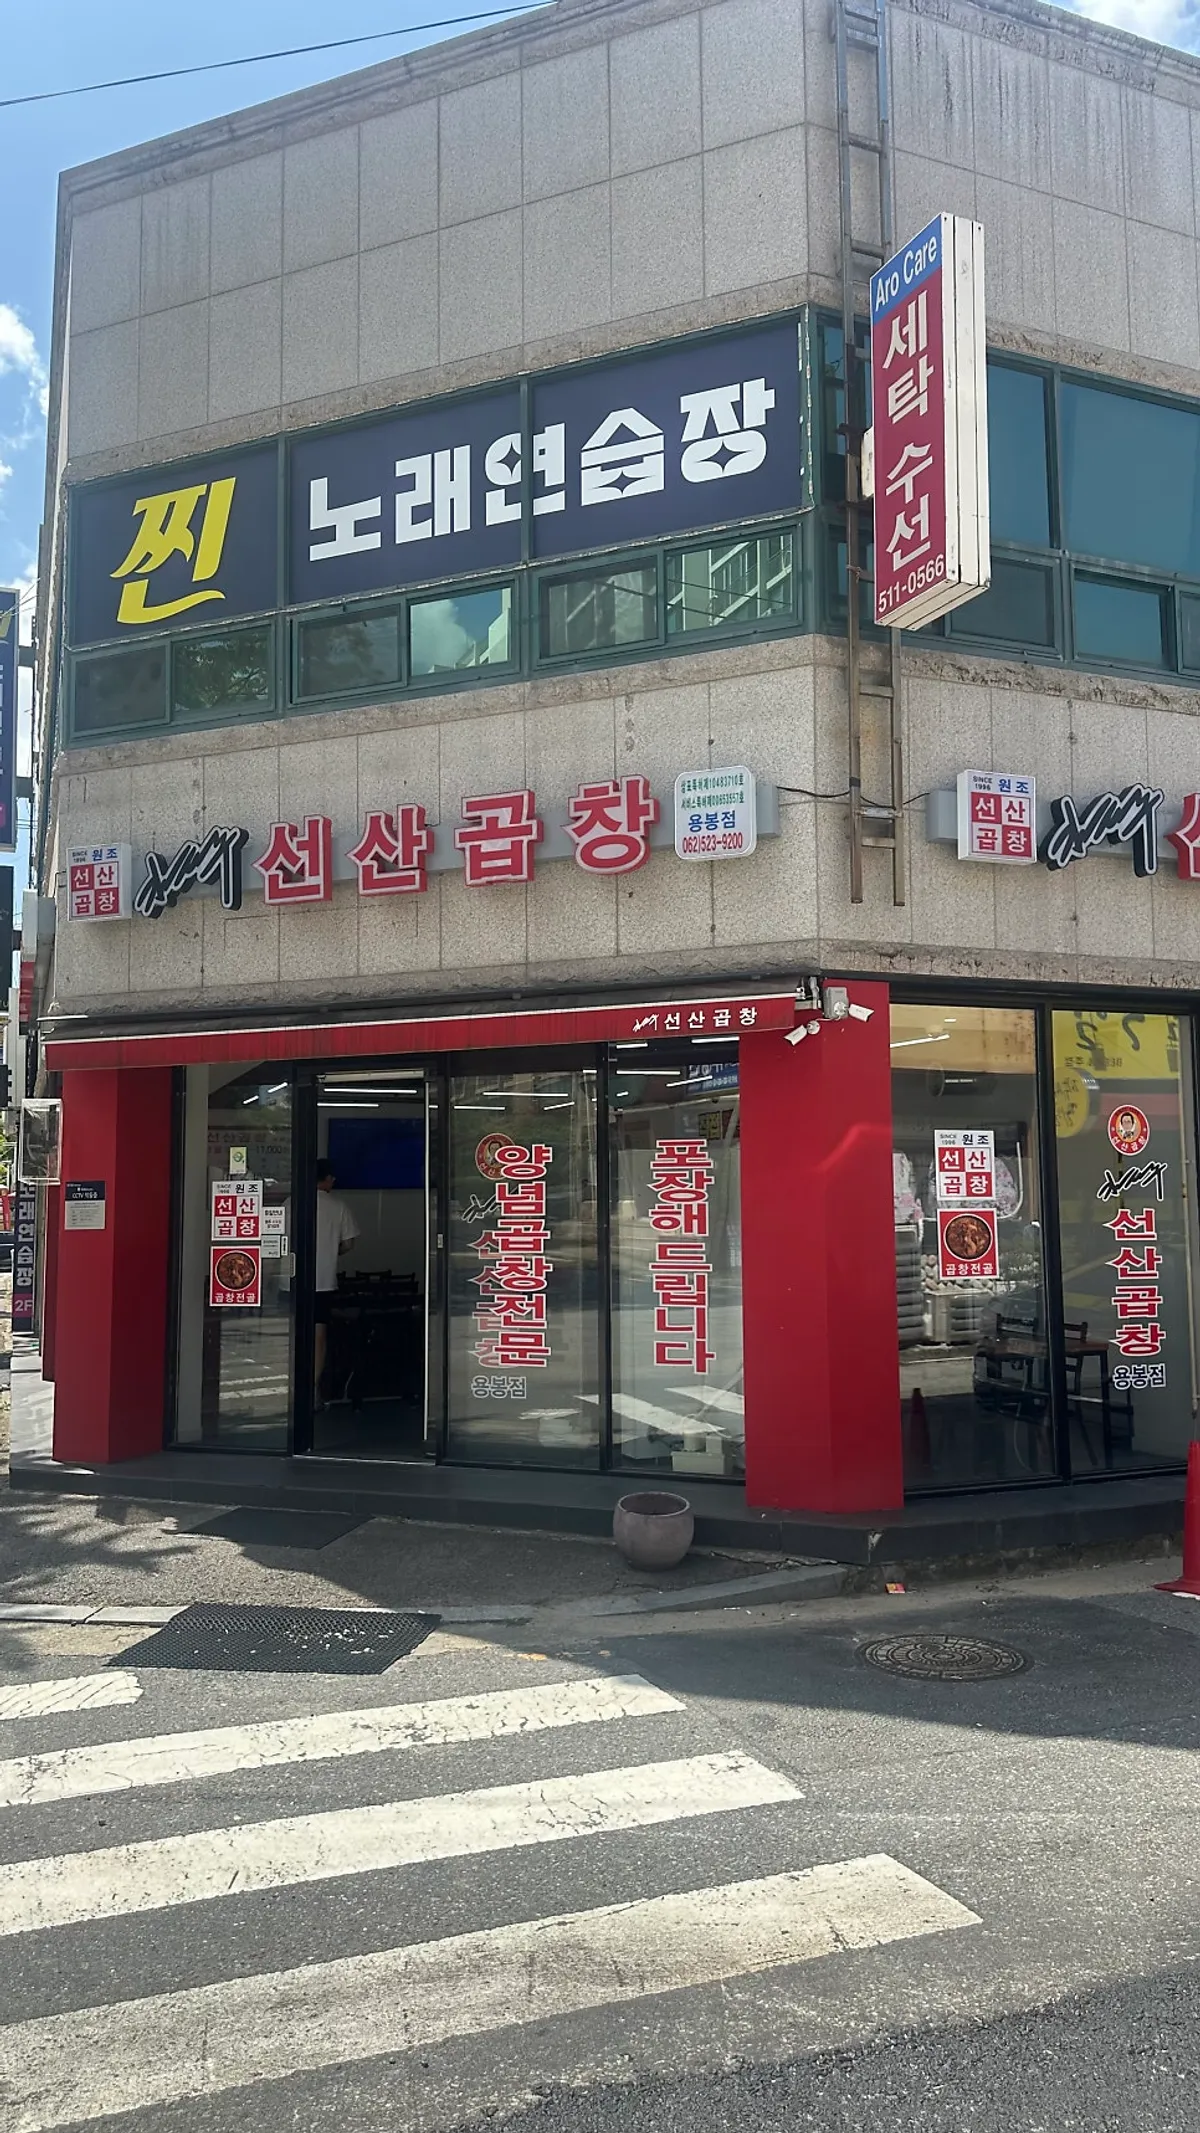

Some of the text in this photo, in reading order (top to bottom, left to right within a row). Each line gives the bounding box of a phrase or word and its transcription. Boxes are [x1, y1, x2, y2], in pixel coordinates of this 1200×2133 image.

[875, 236, 937, 312] Aro Care
[882, 290, 934, 570] 세탁 수선
[109, 378, 775, 624] 찐 노래연습장
[878, 554, 944, 613] 511-0566
[973, 776, 993, 784] SINCE
[998, 778, 1029, 794] 원조
[688, 810, 736, 832] 용봉점
[253, 774, 658, 905] 선산곱창
[683, 832, 743, 853] 062)523-9200
[92, 847, 118, 861] 원조
[663, 1006, 758, 1031] 선산곱창
[962, 1133, 989, 1146] 원조
[235, 1183, 259, 1194] 원조
[490, 1143, 553, 1368] 양념곱창전문
[945, 1262, 993, 1276] 곱창전골
[1103, 1207, 1167, 1358] 선산곱창
[14, 1299, 34, 1312] 2F
[470, 1375, 527, 1399] 용봉점
[1113, 1364, 1167, 1390] 용봉점
